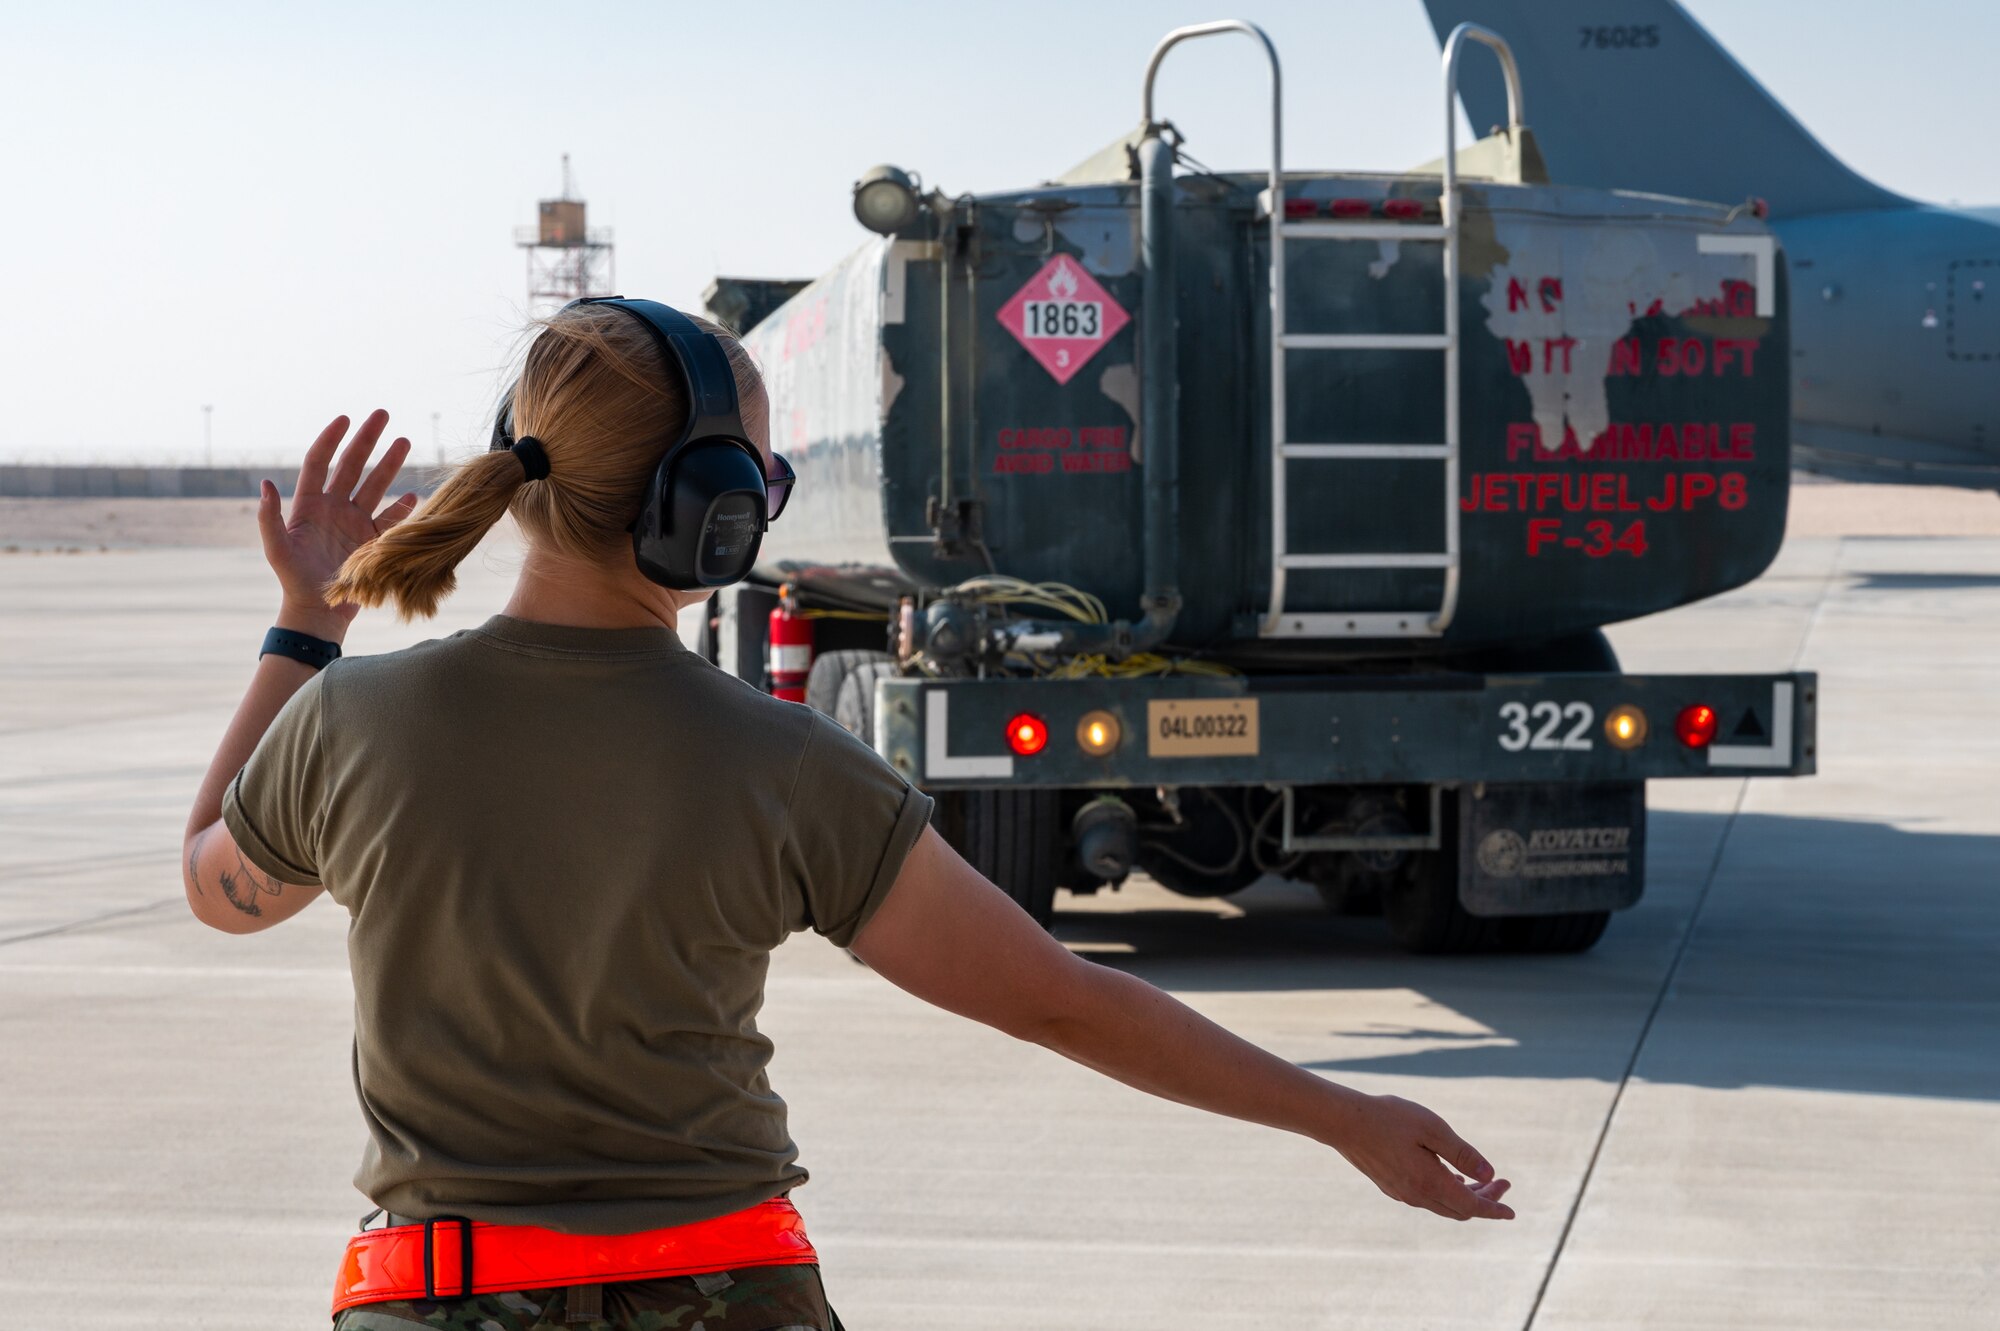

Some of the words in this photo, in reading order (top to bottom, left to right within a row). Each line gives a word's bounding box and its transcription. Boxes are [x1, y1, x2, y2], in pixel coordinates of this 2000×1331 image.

[1029, 304, 1098, 335] 1863
[1056, 349, 1070, 368] 3
[1505, 338, 1641, 375] WITIN
[1658, 338, 1706, 377] 50
[1713, 338, 1760, 376] FT
[998, 429, 1073, 450] CARGO
[1079, 427, 1126, 449] FIRE
[1507, 422, 1756, 462] FLAMMABLE
[993, 453, 1054, 475] AVOID
[1061, 451, 1132, 474] WATER
[1647, 472, 1749, 511] JP8
[1526, 519, 1648, 557] F-34
[1160, 714, 1248, 739] 04L00322
[1498, 701, 1595, 752] 322
[1528, 827, 1631, 850] KOVATCH
